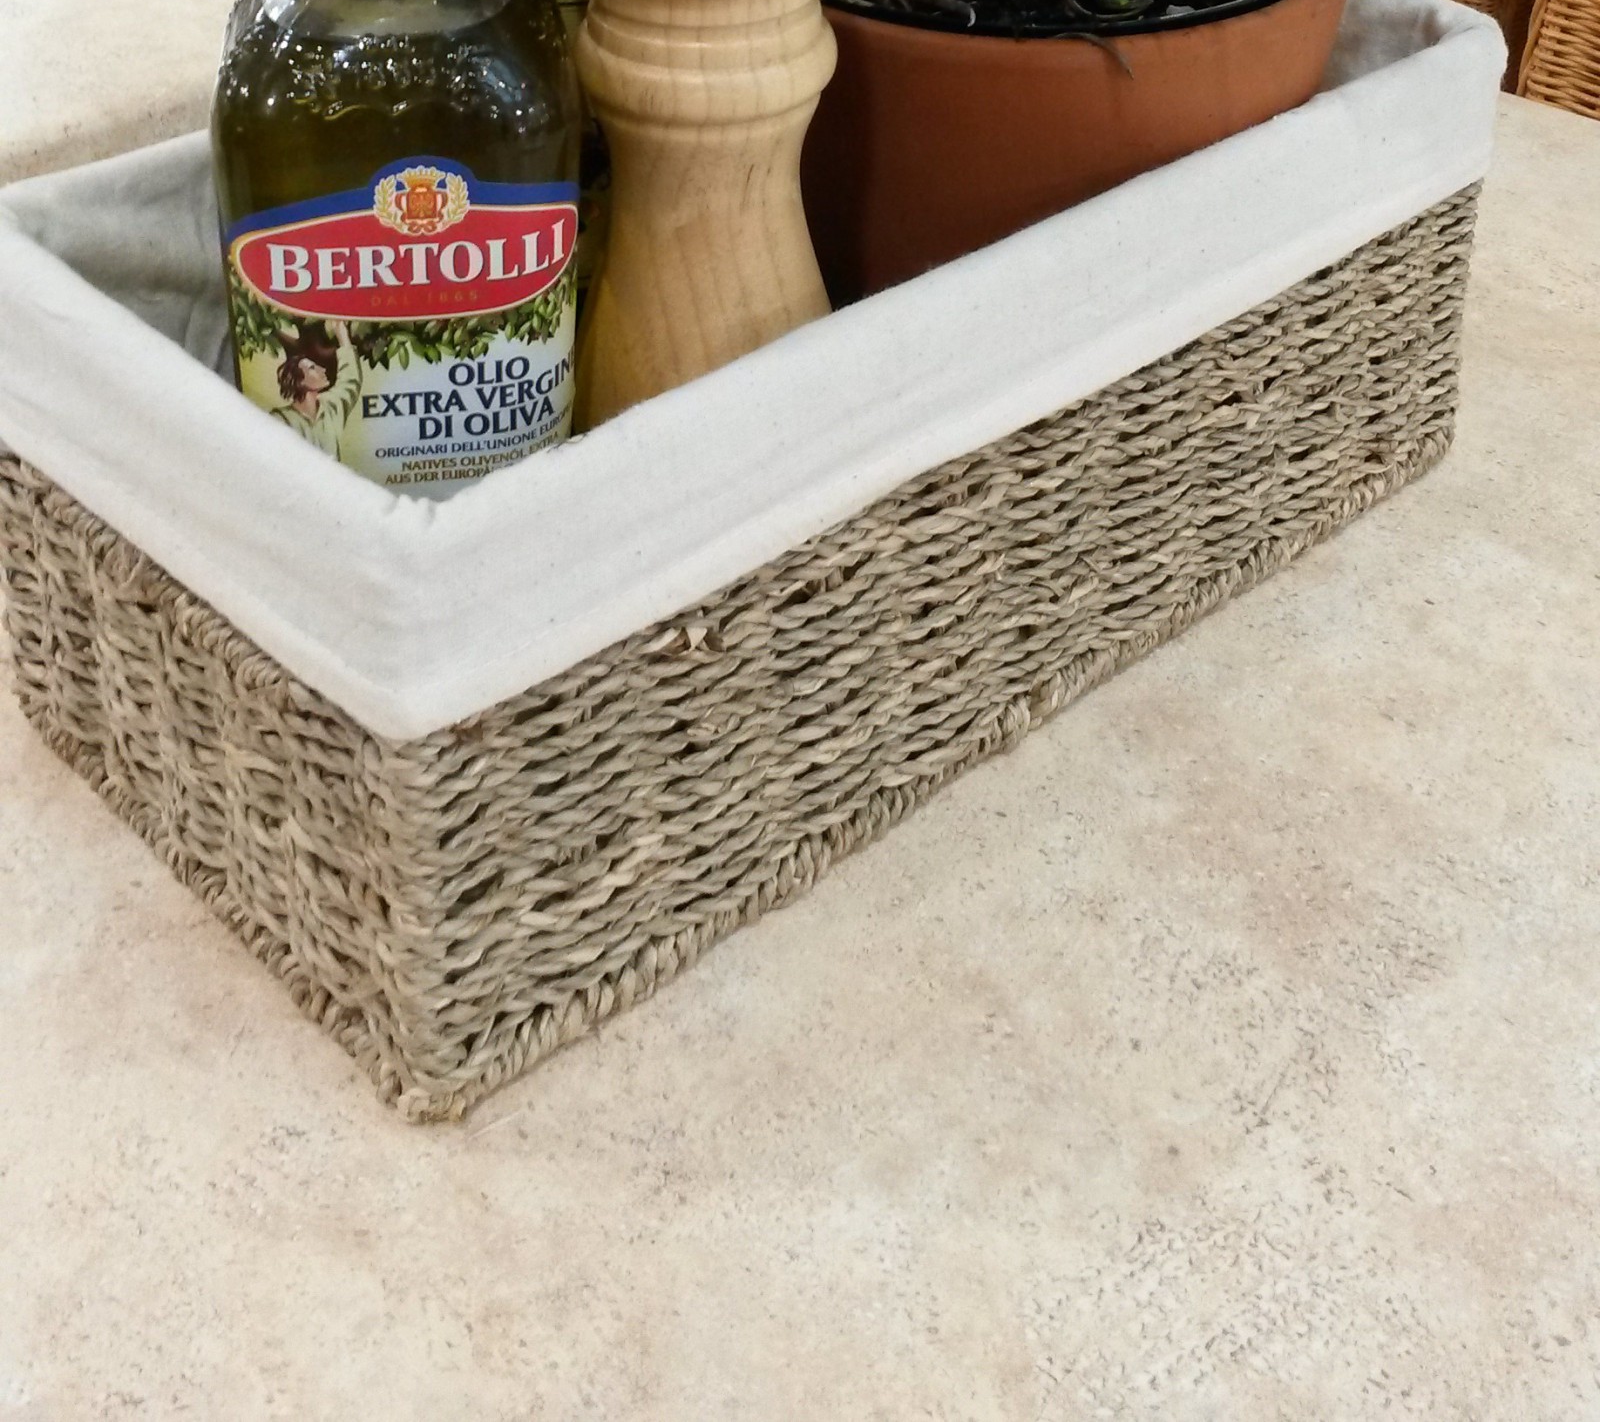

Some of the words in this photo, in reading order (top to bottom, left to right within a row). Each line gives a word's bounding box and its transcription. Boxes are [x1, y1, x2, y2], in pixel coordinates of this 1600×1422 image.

[266, 218, 566, 293] BERTOLLI
[448, 356, 530, 387] OLIO
[362, 389, 468, 420] EXTRA
[419, 415, 454, 441] DI
[463, 396, 555, 437] OLIVA
[375, 444, 448, 459] ORIGINARI
[451, 429, 537, 454] DELL'UNIONE
[540, 400, 572, 436] EUROP
[385, 473, 412, 486] AUS
[414, 470, 440, 483] DER
[402, 457, 457, 472] NATIVES
